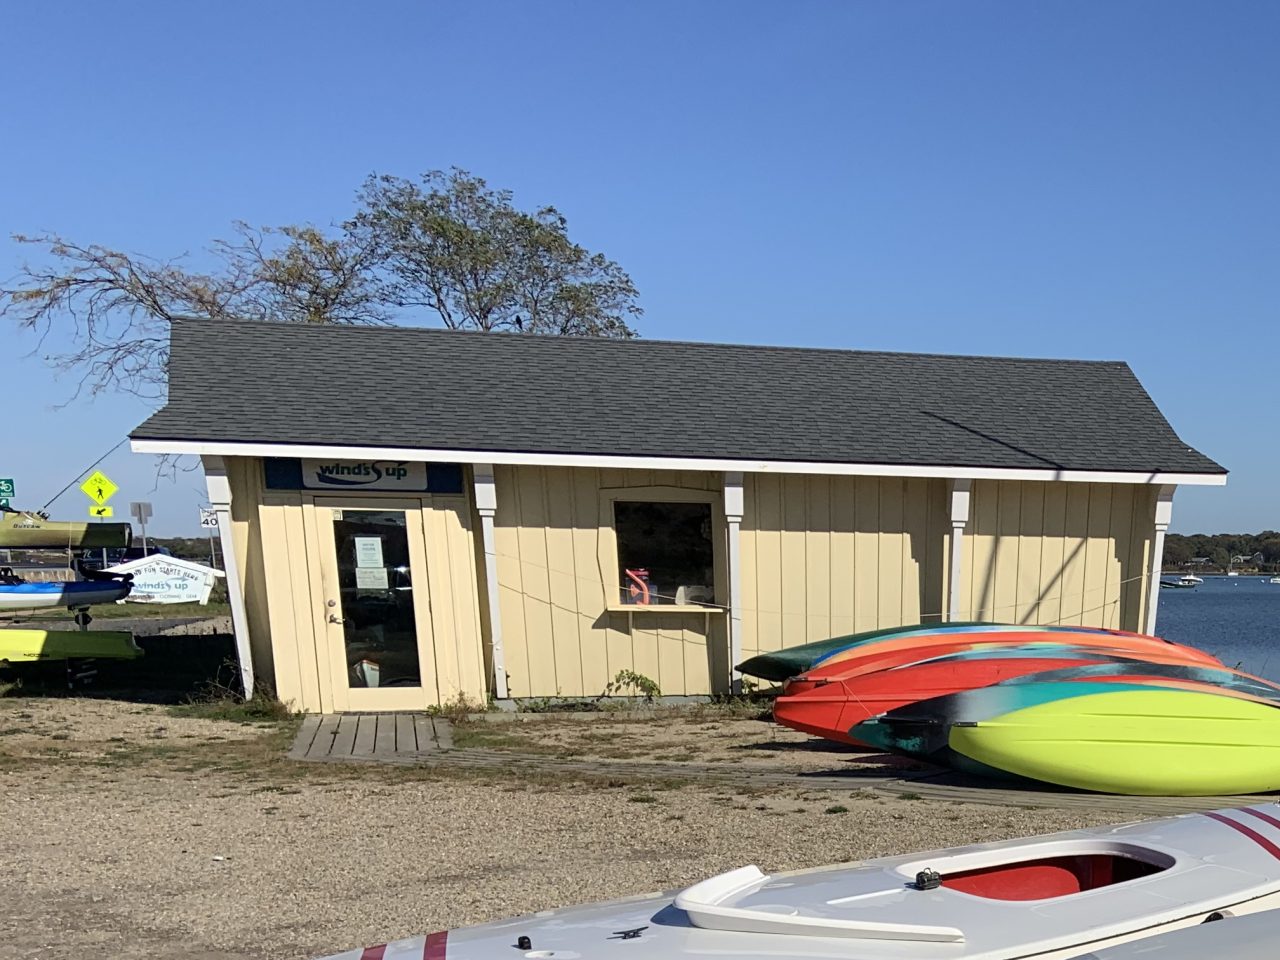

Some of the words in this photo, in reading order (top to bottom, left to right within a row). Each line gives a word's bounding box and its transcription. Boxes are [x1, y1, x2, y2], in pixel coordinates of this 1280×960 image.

[385, 465, 408, 480] up
[202, 518, 218, 526] 40
[159, 566, 181, 576] STARTS
[183, 571, 199, 581] HERE
